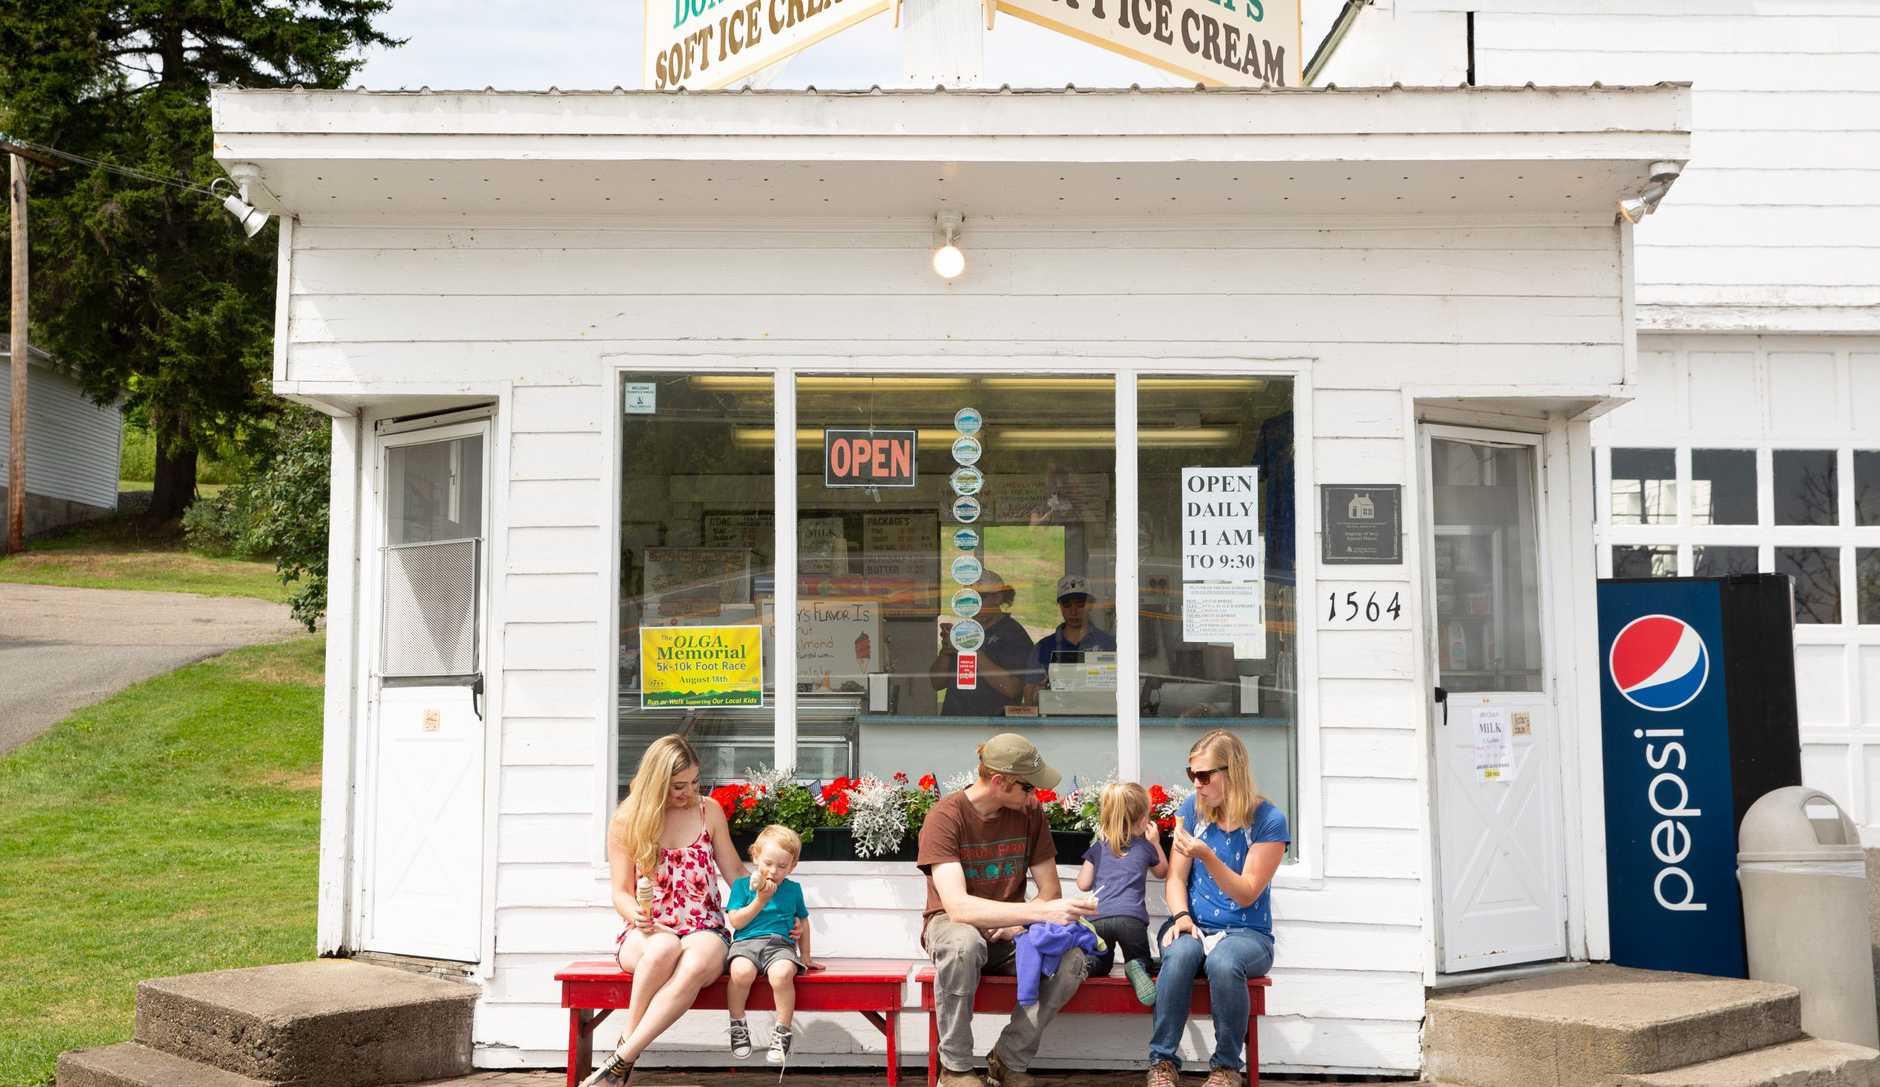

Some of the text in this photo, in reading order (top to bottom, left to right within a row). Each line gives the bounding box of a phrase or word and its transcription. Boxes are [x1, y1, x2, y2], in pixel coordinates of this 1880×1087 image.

[655, 24, 713, 91] SOFT
[719, 0, 762, 61] ICE
[1119, 0, 1285, 87] ICE CREAM
[831, 438, 910, 478] OPEN
[1187, 475, 1252, 492] OPEN
[1187, 502, 1253, 517] DAILY
[1189, 529, 1253, 545] 11 AM
[1187, 554, 1255, 569] TO 9:30
[1329, 591, 1400, 622] 1564
[673, 635, 722, 648] OLGA
[657, 645, 746, 660] Memorial
[695, 662, 718, 671] Foot
[722, 661, 746, 670] Race
[679, 676, 710, 685] August
[1479, 722, 1502, 734] MILK
[1633, 729, 1707, 911] pepsi
